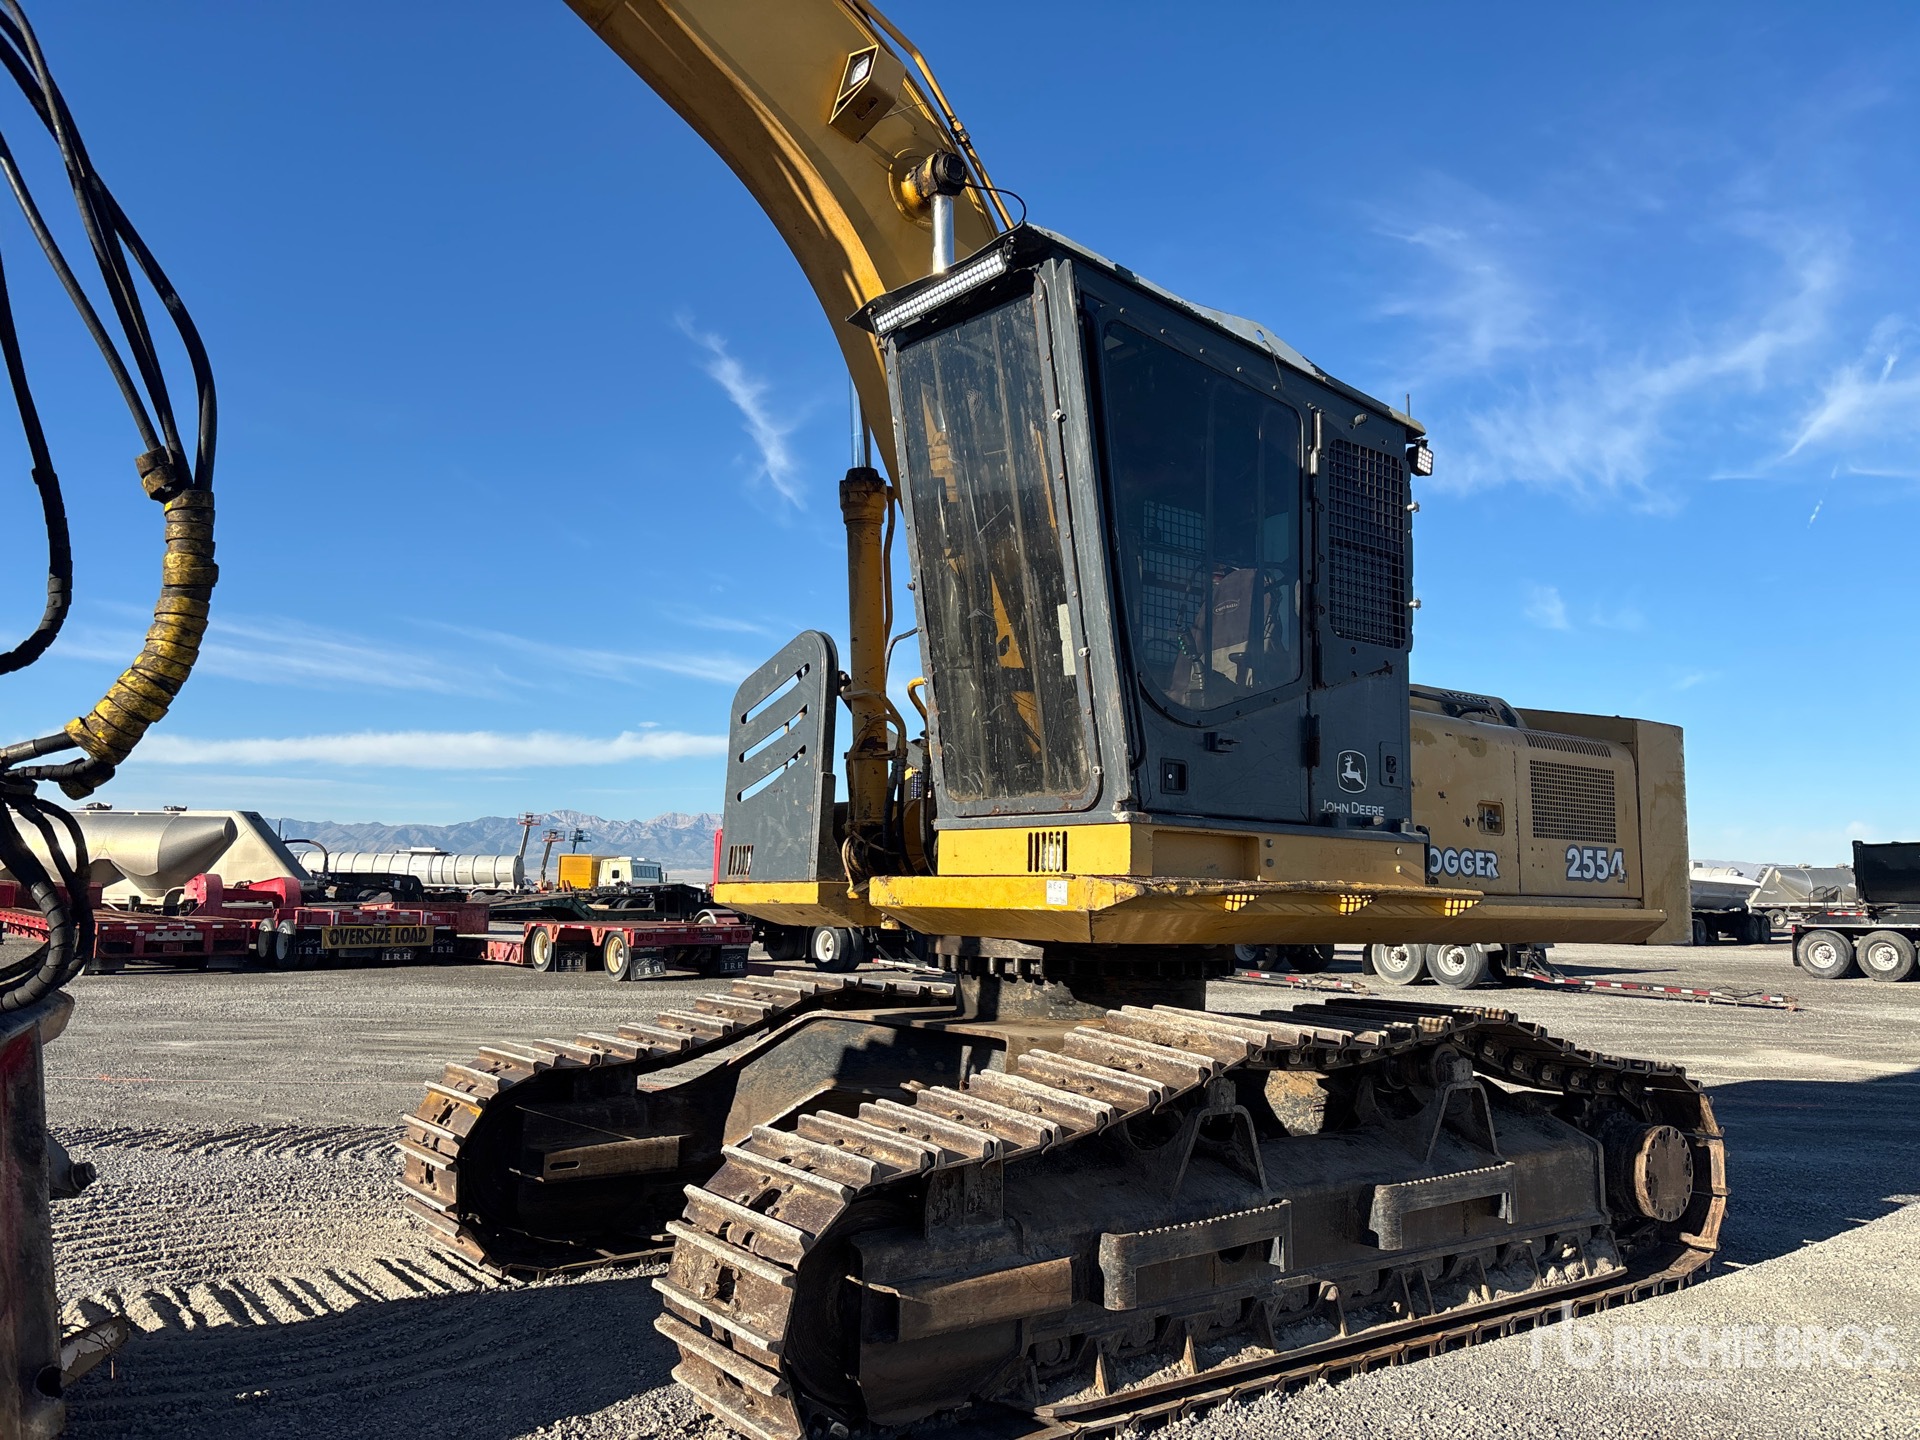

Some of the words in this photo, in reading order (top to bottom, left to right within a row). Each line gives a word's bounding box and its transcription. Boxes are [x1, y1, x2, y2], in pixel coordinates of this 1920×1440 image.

[1320, 800, 1349, 813] JOHN
[1351, 802, 1385, 816] DEERE
[1429, 847, 1499, 878] OGGER
[329, 928, 391, 945] OVERSIZE
[394, 926, 427, 943] LOAD
